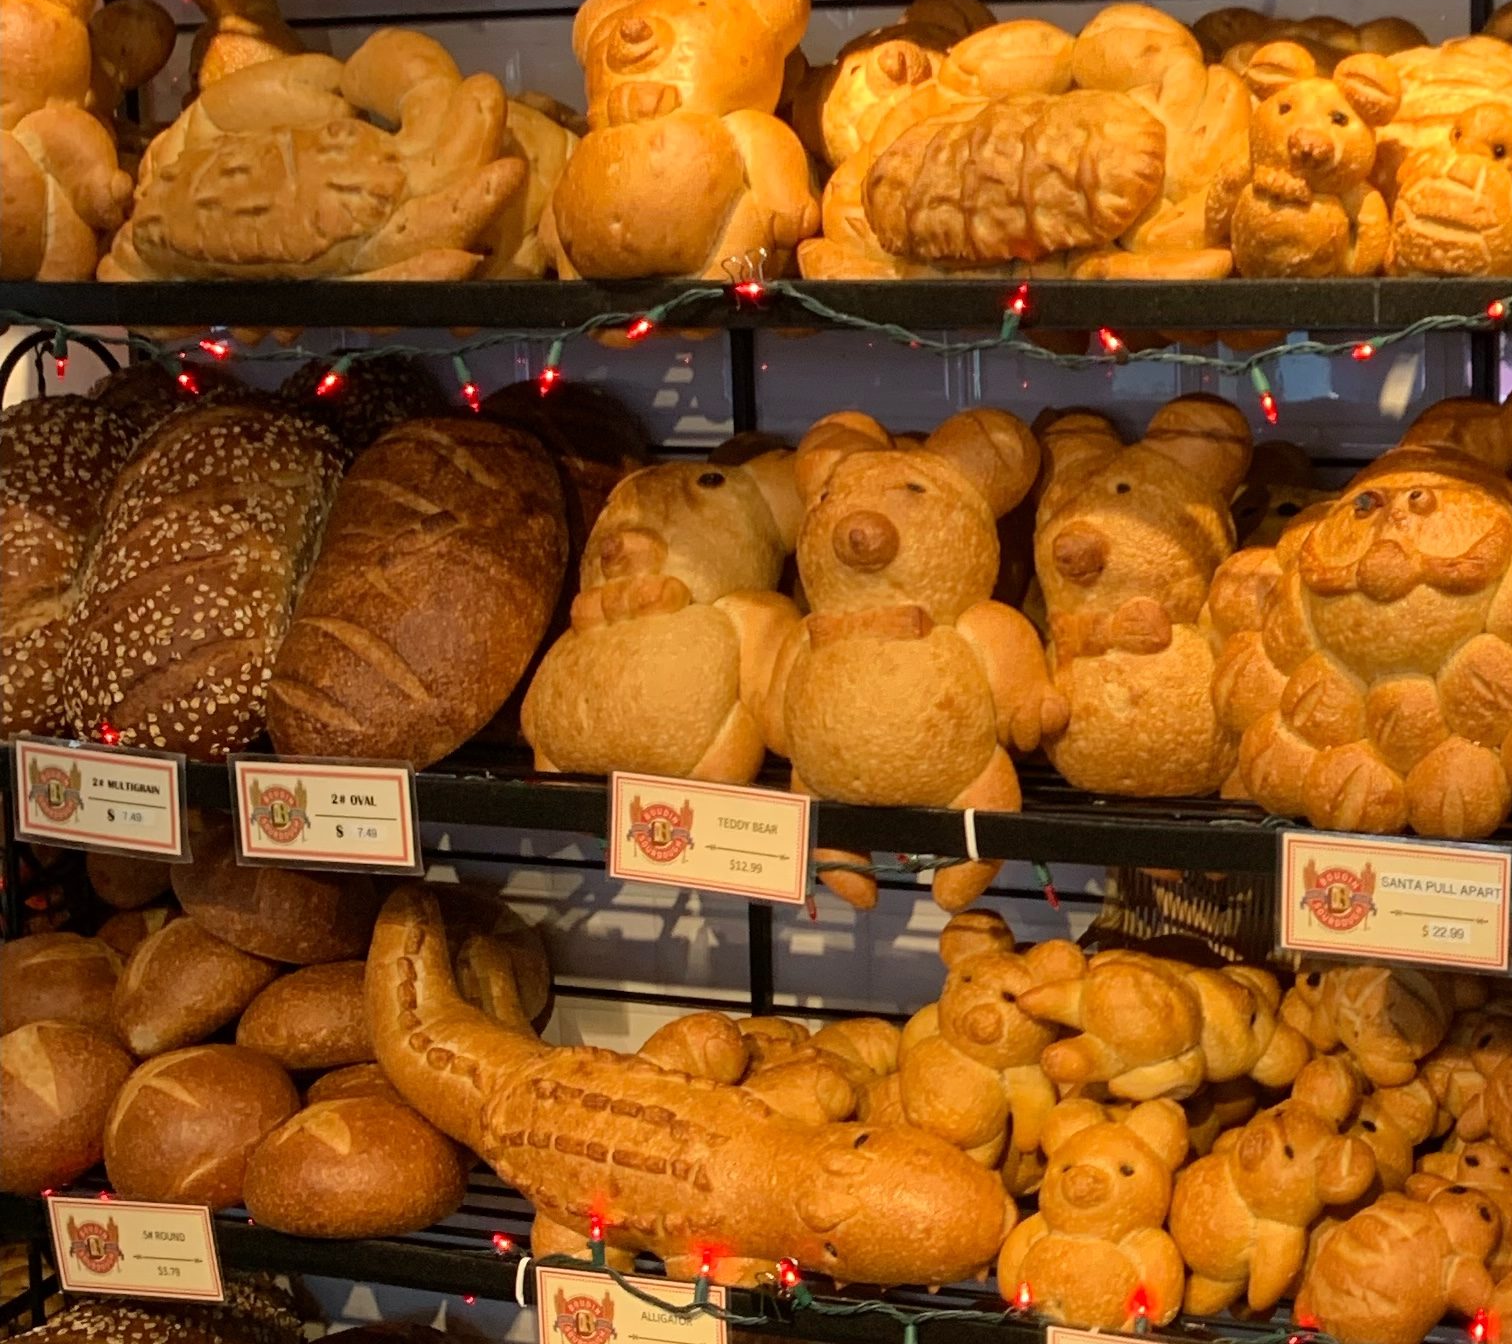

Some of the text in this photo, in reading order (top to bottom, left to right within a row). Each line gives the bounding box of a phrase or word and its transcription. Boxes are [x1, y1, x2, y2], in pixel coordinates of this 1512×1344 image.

[331, 793, 377, 807] 2# OVAL
[357, 827, 378, 839] 7.49
[718, 817, 779, 834] TEDDY BEAR
[729, 859, 763, 874] $12.99
[1318, 869, 1361, 891] BOUDIN
[1381, 876, 1502, 900] SANTA PULL APART
[1432, 927, 1465, 939] 22.99
[641, 1311, 694, 1327] ALLIGATOR
